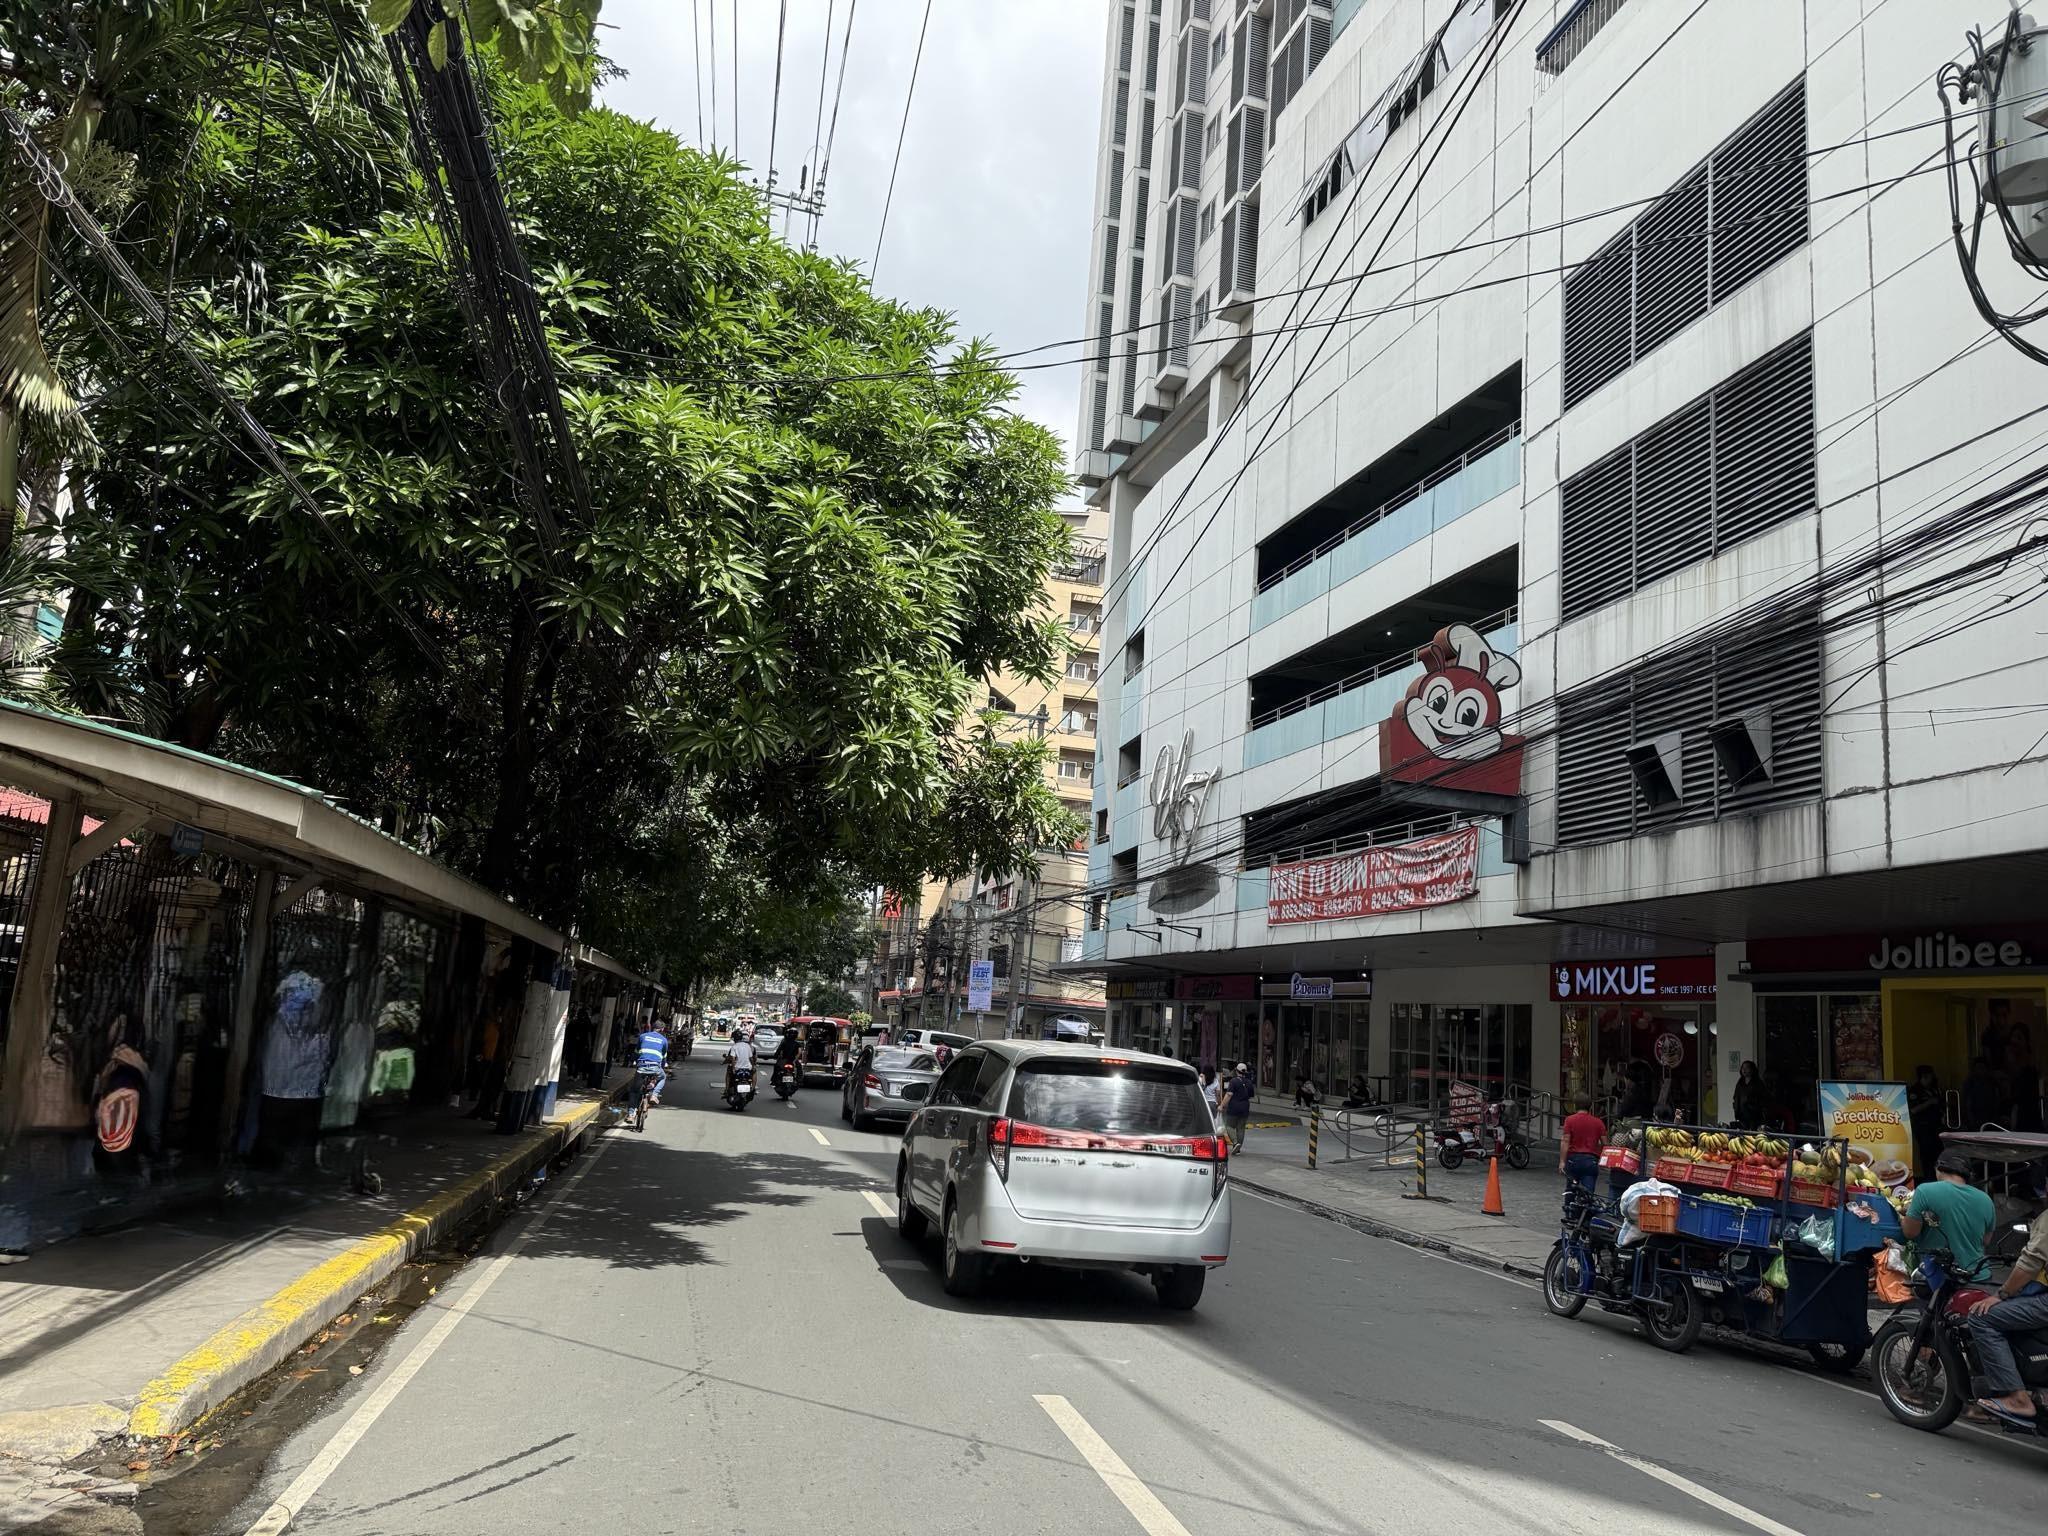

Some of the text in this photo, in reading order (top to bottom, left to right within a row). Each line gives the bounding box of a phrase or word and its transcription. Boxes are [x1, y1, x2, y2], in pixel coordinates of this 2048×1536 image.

[1868, 931, 2023, 969] Jollibee
[1575, 964, 1656, 995] MIXUE
[1660, 985, 1679, 994] SINCE
[1846, 1092, 1875, 1101] Jollibee
[1833, 1108, 1901, 1125] Breakfast
[1855, 1125, 1884, 1142] Joys
